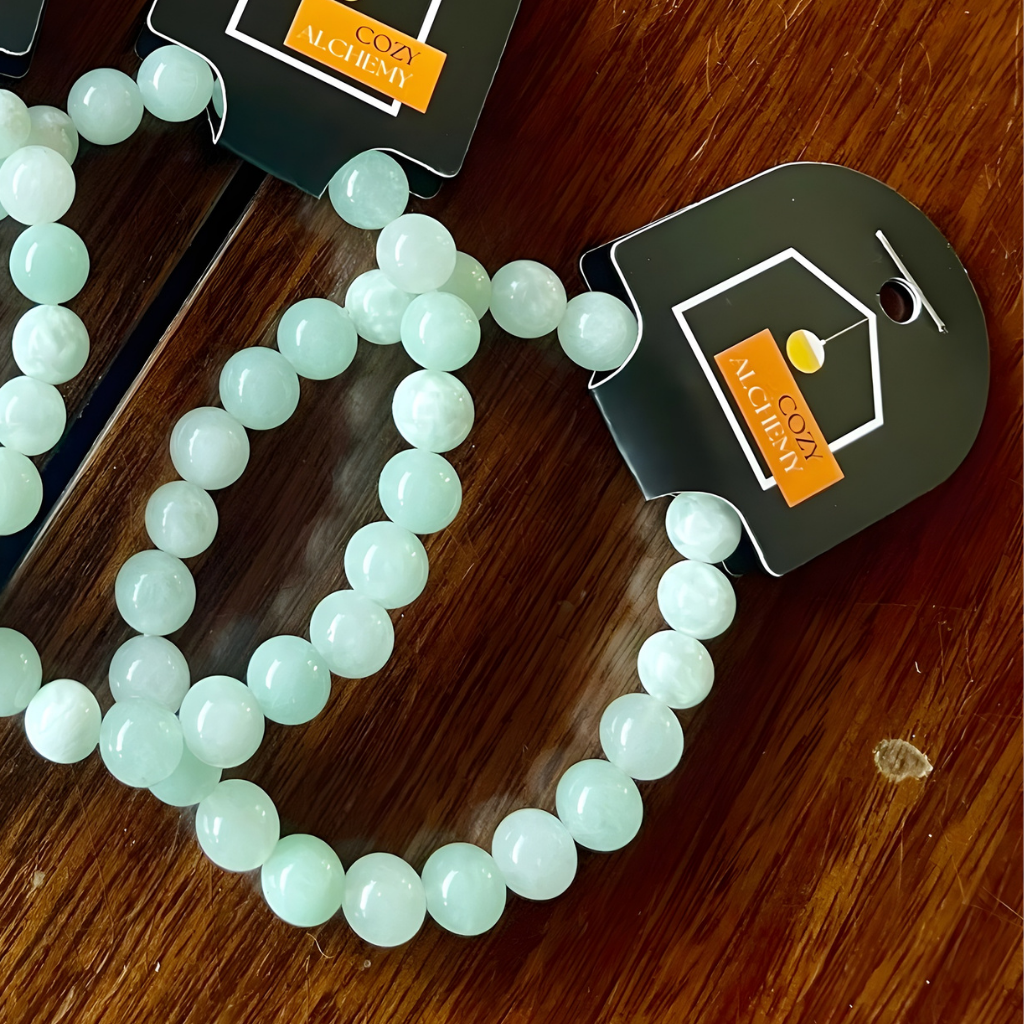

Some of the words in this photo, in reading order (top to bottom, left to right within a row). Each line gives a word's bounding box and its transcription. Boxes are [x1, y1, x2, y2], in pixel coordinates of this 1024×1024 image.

[296, 25, 413, 89] ALCHEMY
[355, 26, 421, 66] COZY
[729, 358, 804, 473] ALCHEMY
[778, 394, 823, 460] COZY
